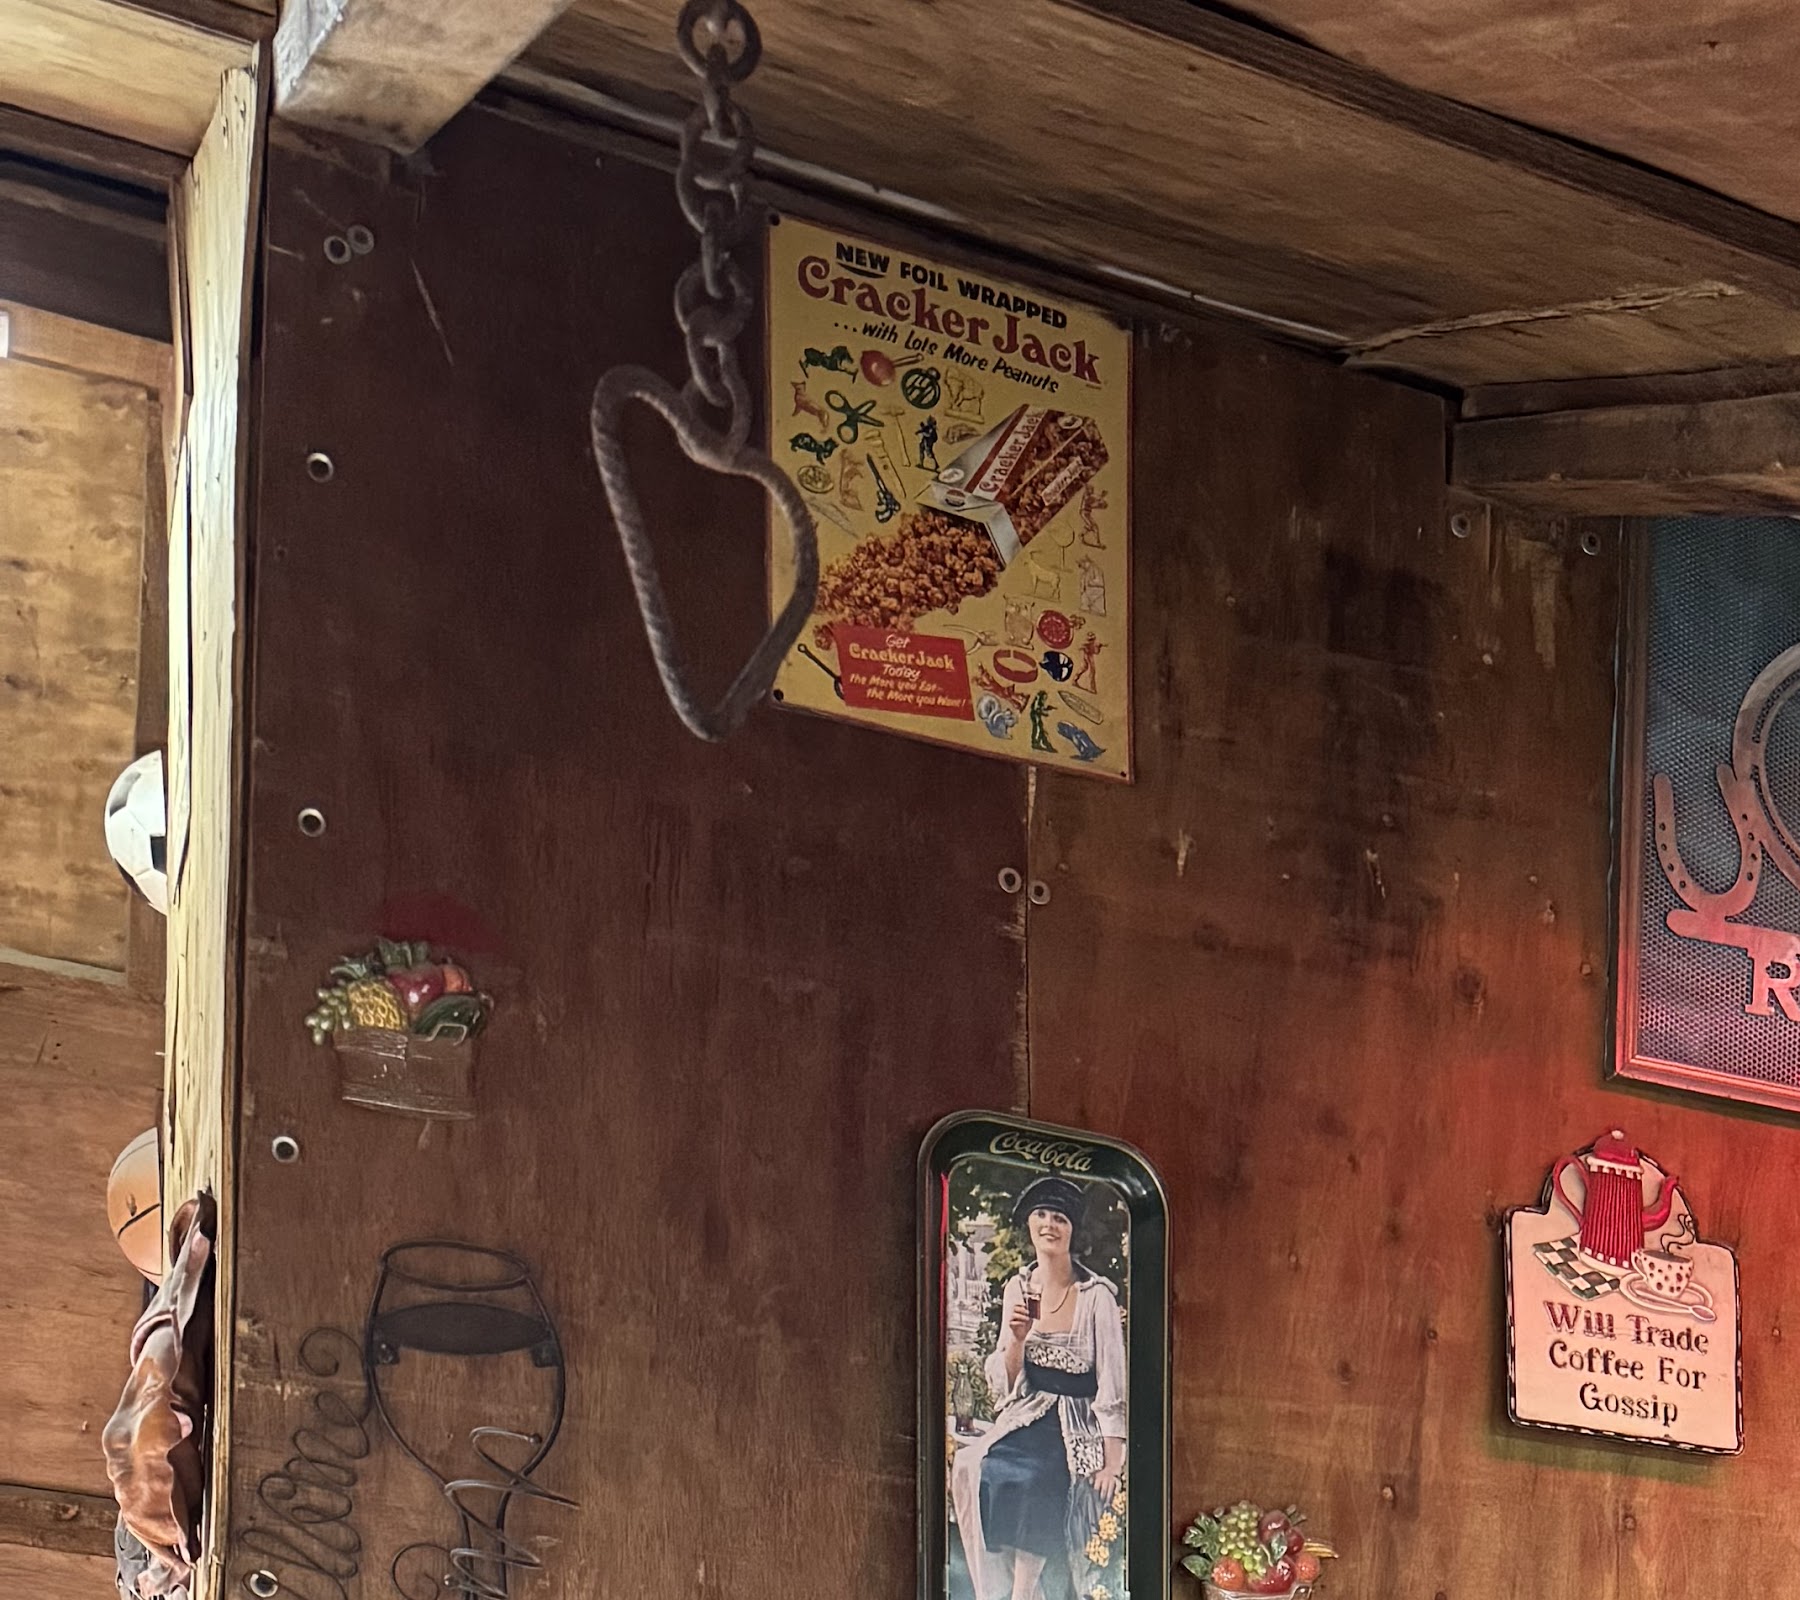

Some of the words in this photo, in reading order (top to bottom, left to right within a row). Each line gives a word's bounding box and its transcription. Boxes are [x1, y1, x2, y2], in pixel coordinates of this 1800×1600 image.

[836, 241, 890, 274] NEW
[900, 261, 949, 292] FOIL
[957, 278, 1068, 330] WRAPPED
[798, 255, 990, 346] Cracker
[992, 313, 1102, 385] Jack
[904, 330, 938, 356] Lots
[943, 344, 988, 371] More
[992, 360, 1059, 394] Peanuts
[849, 643, 915, 665] Cracker
[916, 651, 955, 671] Jack
[883, 664, 921, 681] Today
[1543, 1300, 1616, 1340] Will
[1625, 1313, 1709, 1355] Trade
[1549, 1339, 1645, 1381] Coffee
[1657, 1356, 1707, 1392] For
[1579, 1381, 1679, 1427] Gossip
